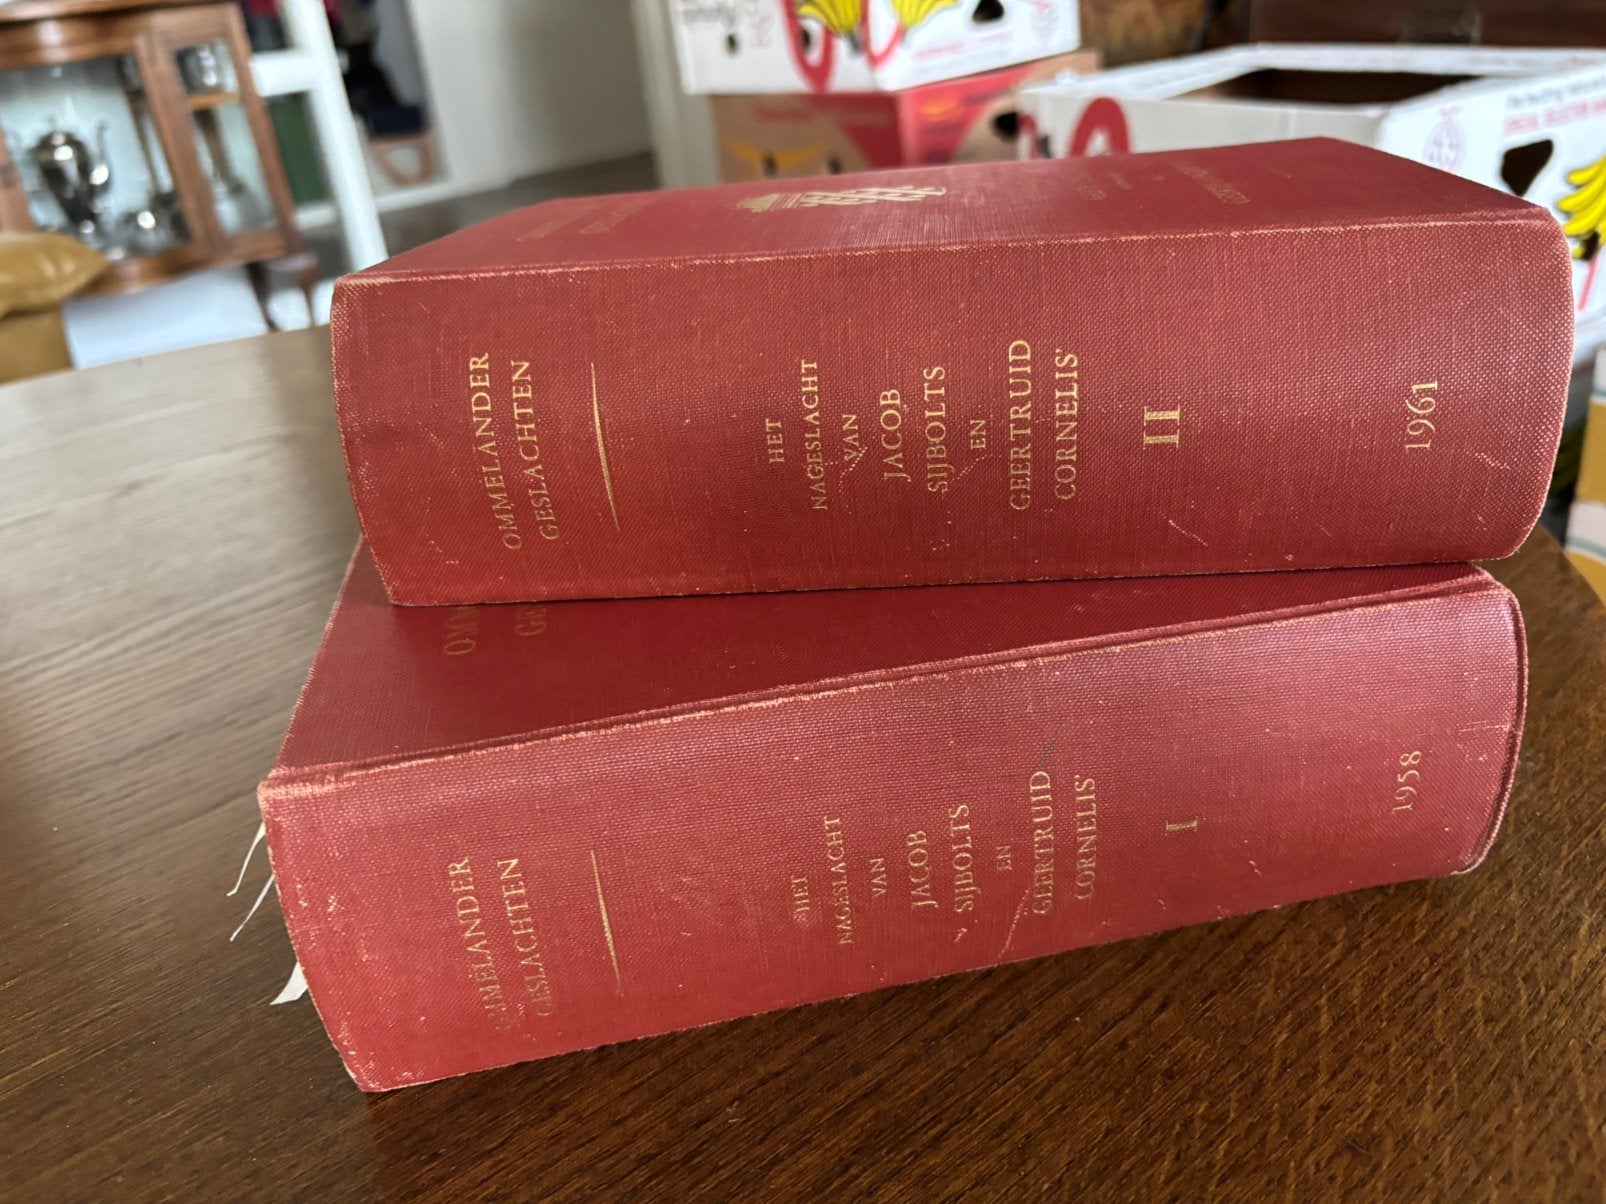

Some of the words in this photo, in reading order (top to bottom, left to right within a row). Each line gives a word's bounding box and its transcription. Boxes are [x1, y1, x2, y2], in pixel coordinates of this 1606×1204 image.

[469, 353, 522, 550] OMMELANDER
[510, 360, 560, 540] GESLACHTEN
[765, 418, 785, 464] HET
[801, 359, 827, 511] NAGESLACHT
[842, 414, 858, 462] VAN
[880, 389, 911, 482] JACOB
[923, 366, 954, 493] SIJBOLTS
[970, 419, 987, 450] EN
[1008, 339, 1032, 511] GEERTRUID
[1143, 405, 1181, 450] II
[1405, 380, 1439, 450] 1961
[1392, 751, 1422, 814] 1958
[823, 815, 854, 945] NAGESLACHT
[869, 857, 887, 898] VAN
[906, 830, 939, 909] JACOB
[949, 804, 981, 913] SIJBOLTS
[996, 845, 1013, 871] EN
[1030, 770, 1054, 914] GEERTRUID
